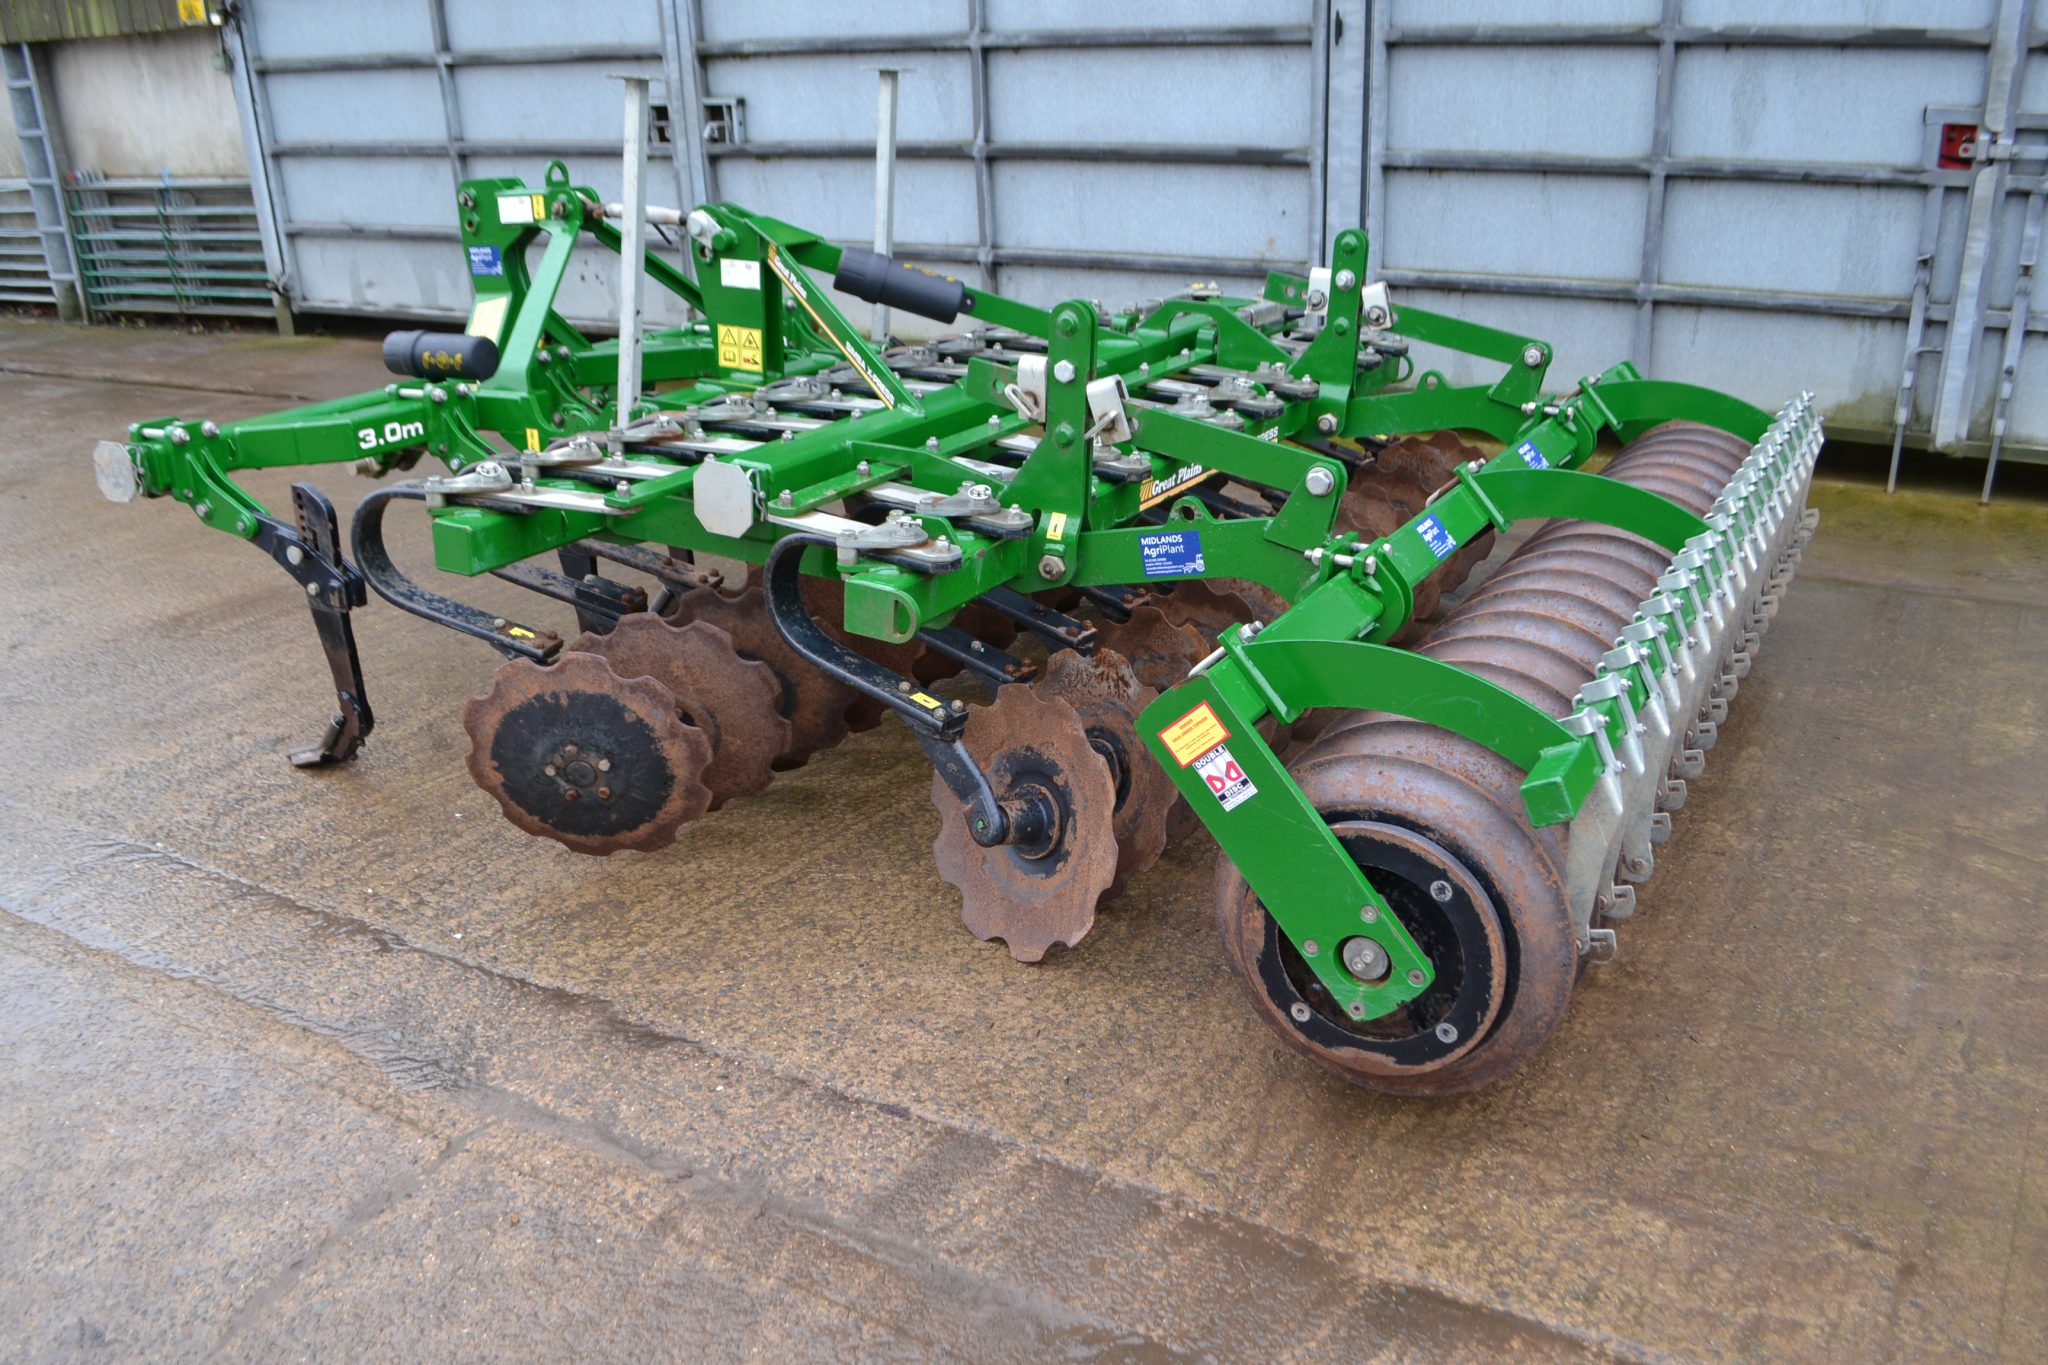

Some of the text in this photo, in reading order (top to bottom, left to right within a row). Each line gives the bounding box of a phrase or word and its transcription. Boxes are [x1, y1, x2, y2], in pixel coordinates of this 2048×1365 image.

[358, 421, 424, 450] 3.0m
[1152, 475, 1177, 496] Great
[1140, 534, 1183, 546] MIDLANDS
[1143, 544, 1185, 558] AgriPlant
[1195, 746, 1224, 769] DOUBLE
[1224, 783, 1243, 798] DISC
